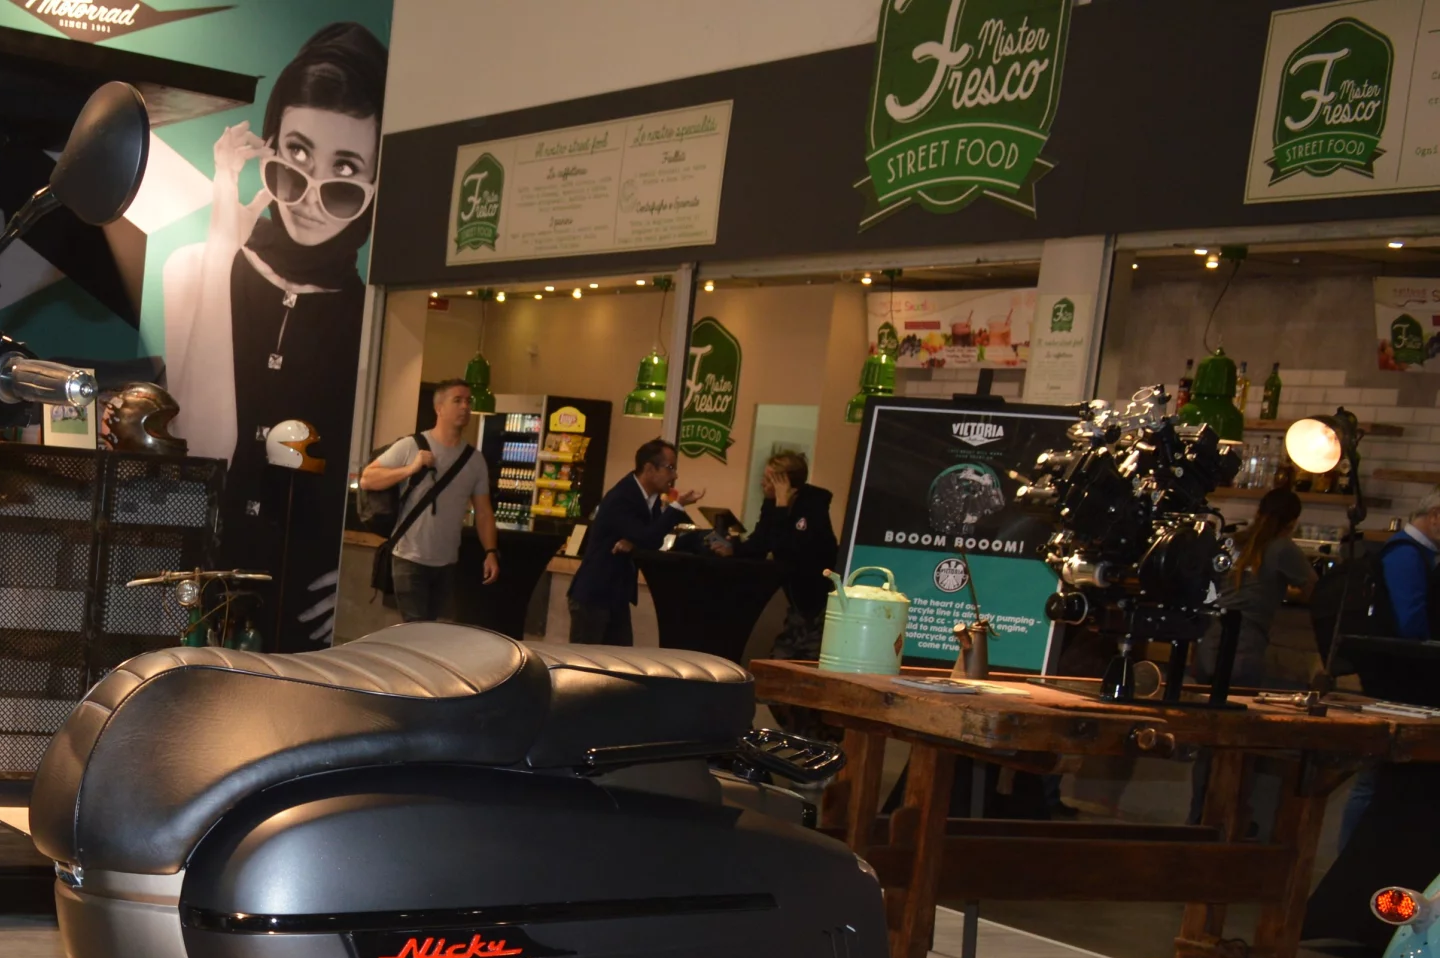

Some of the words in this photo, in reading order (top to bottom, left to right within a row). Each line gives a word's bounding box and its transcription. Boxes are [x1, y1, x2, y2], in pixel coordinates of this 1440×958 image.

[59, 19, 88, 30] SINCE
[978, 16, 1050, 64] Mister
[1284, 48, 1381, 131] Fresco
[1340, 79, 1381, 105] Mister
[887, 140, 949, 183] STREET
[955, 138, 1019, 170] FOOD
[1285, 140, 1324, 162] STREET
[1327, 139, 1365, 156] FOOD
[705, 373, 733, 395] Mister
[682, 425, 695, 438] EET
[696, 425, 722, 443] FOOD
[952, 422, 1004, 438] VICTORIA
[885, 530, 946, 547] BOOOM
[954, 537, 1025, 553] BOOOM!
[913, 597, 928, 606] The
[929, 599, 953, 608] heart
[955, 600, 964, 609] of
[908, 606, 935, 616] orcyle
[936, 608, 951, 617] line
[953, 609, 960, 618] is
[996, 614, 1035, 626] pumping
[919, 623, 928, 631] to
[929, 625, 953, 634] make
[996, 623, 1029, 634] engine,
[918, 640, 941, 650] come
